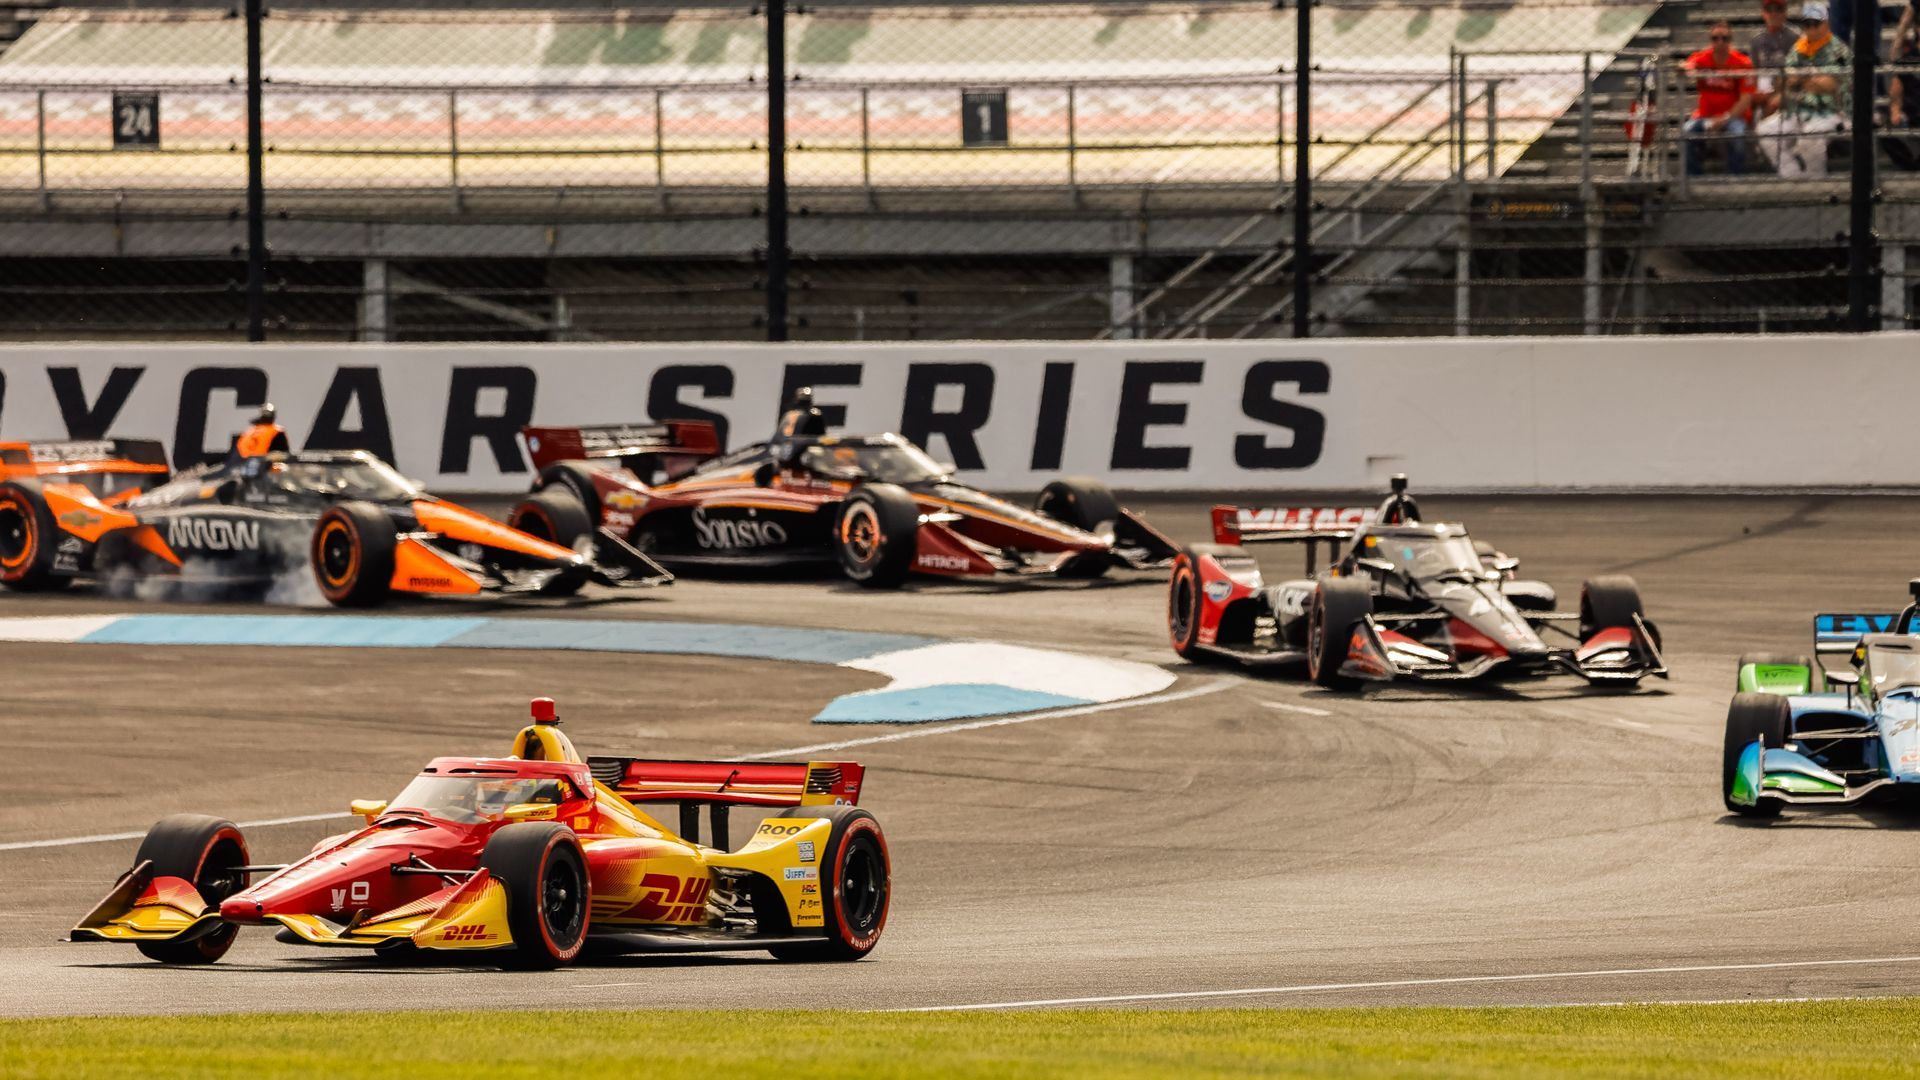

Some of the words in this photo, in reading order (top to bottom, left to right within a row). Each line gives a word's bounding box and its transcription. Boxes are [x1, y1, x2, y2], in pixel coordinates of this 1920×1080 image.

[119, 105, 152, 136] 24
[976, 104, 992, 134] 1
[0, 365, 538, 475] YCAR
[647, 360, 1331, 471] SERIES
[691, 506, 788, 549] Sonsio
[918, 554, 970, 571] HITACHI
[758, 824, 807, 836] ROO
[442, 925, 488, 941] DHL
